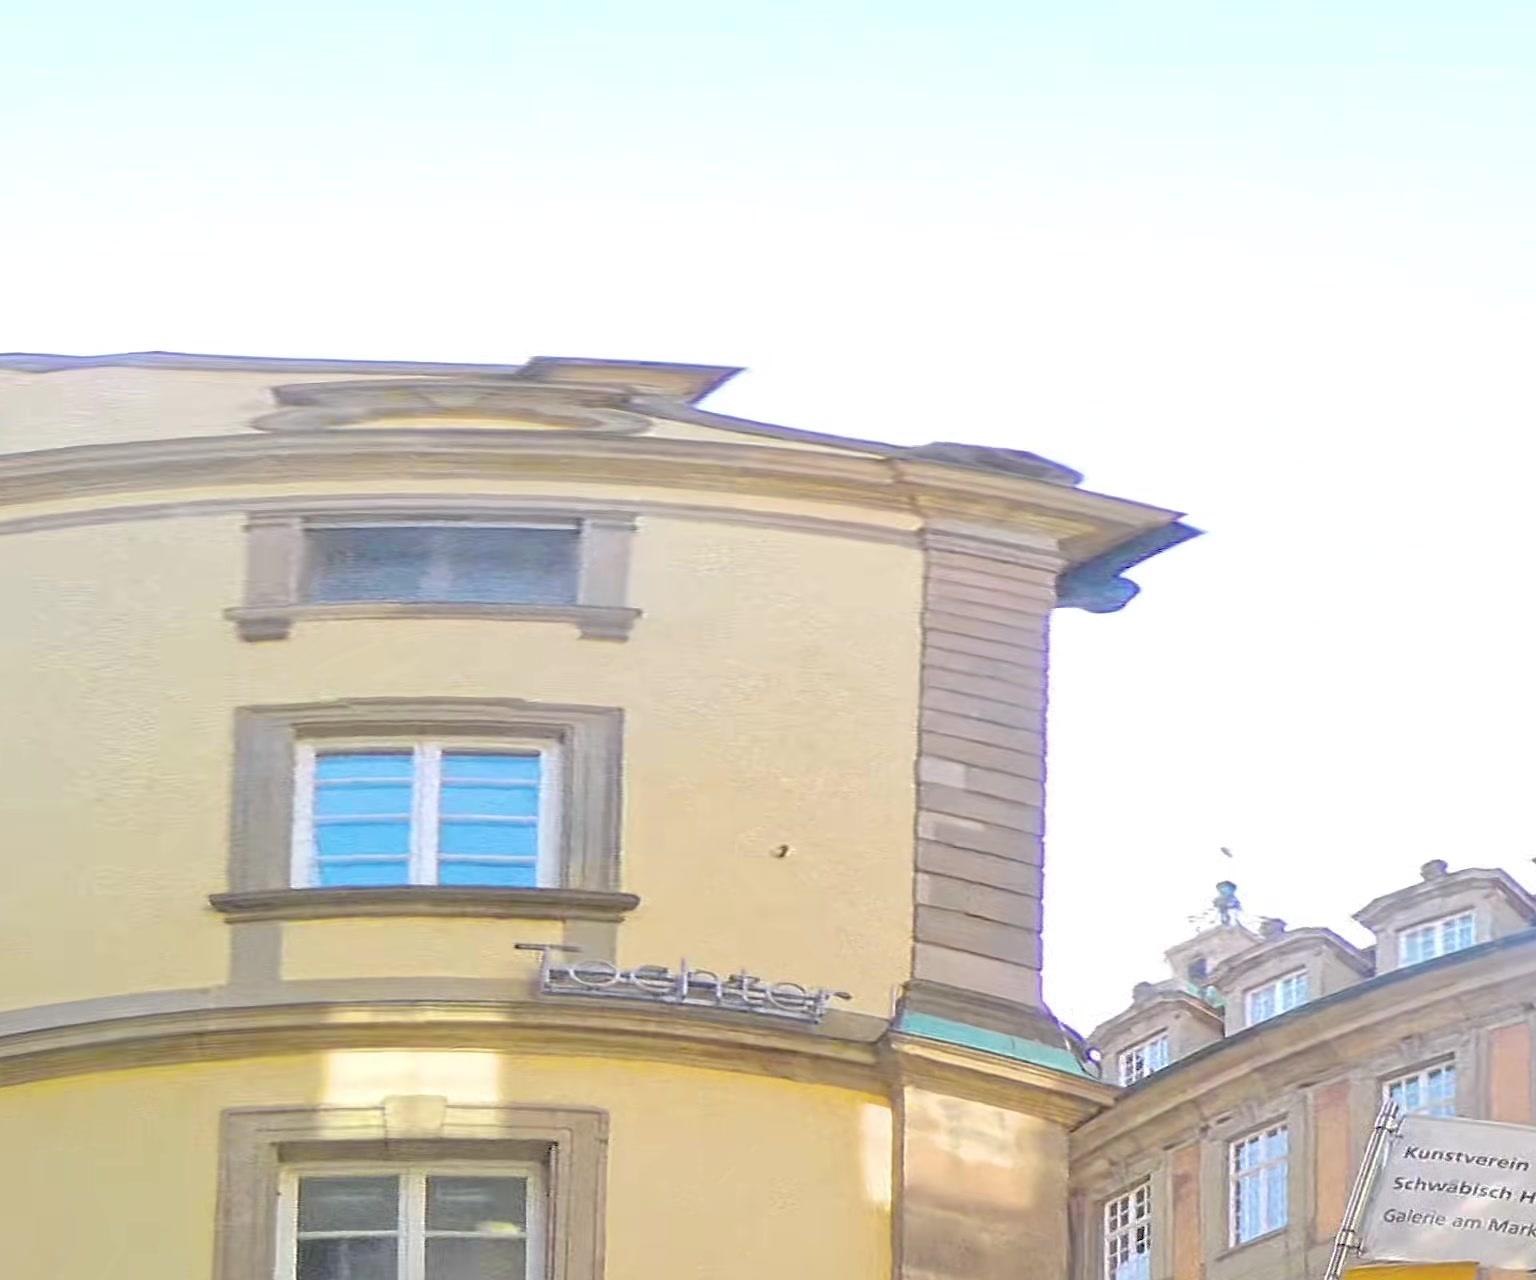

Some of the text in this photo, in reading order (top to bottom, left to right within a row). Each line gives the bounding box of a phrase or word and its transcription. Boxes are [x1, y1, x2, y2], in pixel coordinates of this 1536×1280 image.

[1403, 1146, 1530, 1172] Kunstverein
[1393, 1176, 1513, 1202] Schwäbisch
[1383, 1208, 1447, 1227] Galerie
[1452, 1215, 1482, 1231] am
